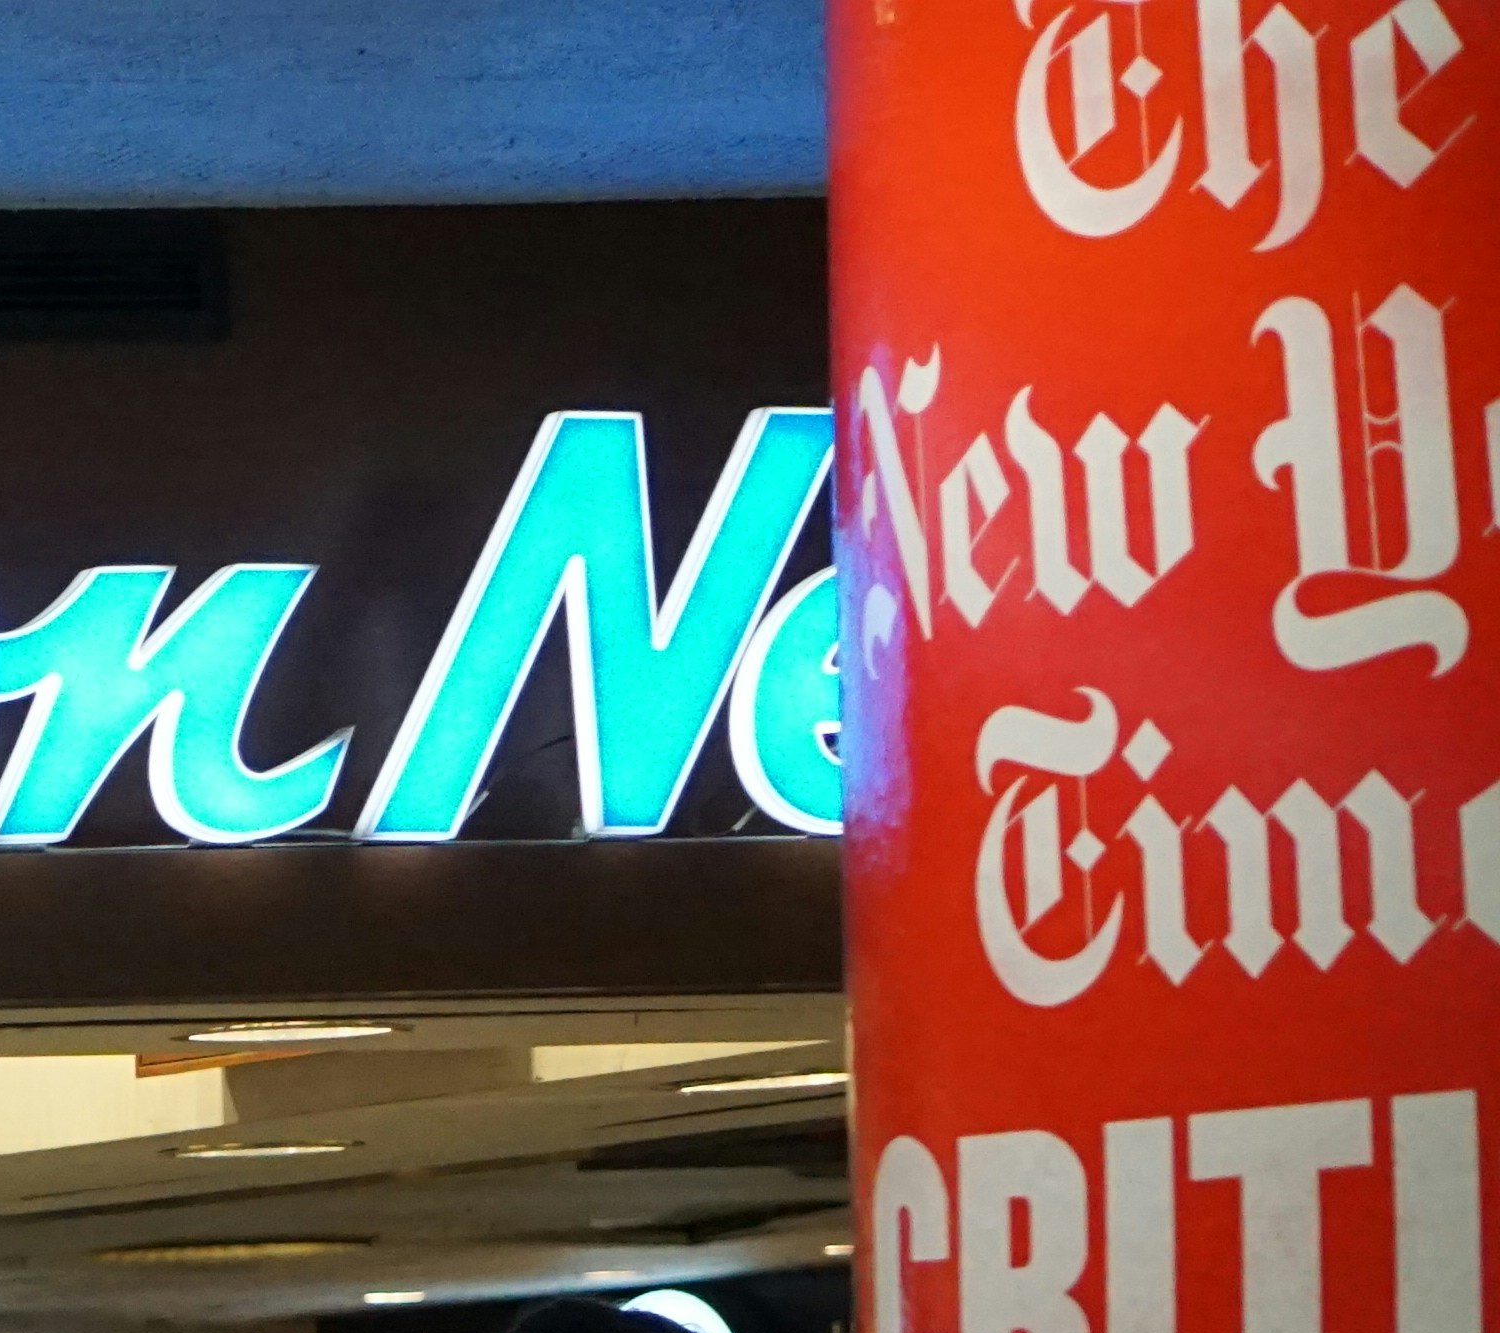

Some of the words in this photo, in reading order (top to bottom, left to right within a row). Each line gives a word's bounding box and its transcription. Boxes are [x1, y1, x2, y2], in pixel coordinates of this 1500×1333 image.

[1016, 0, 1477, 253] The
[859, 343, 1211, 679] New
[1250, 283, 1500, 679] Y
